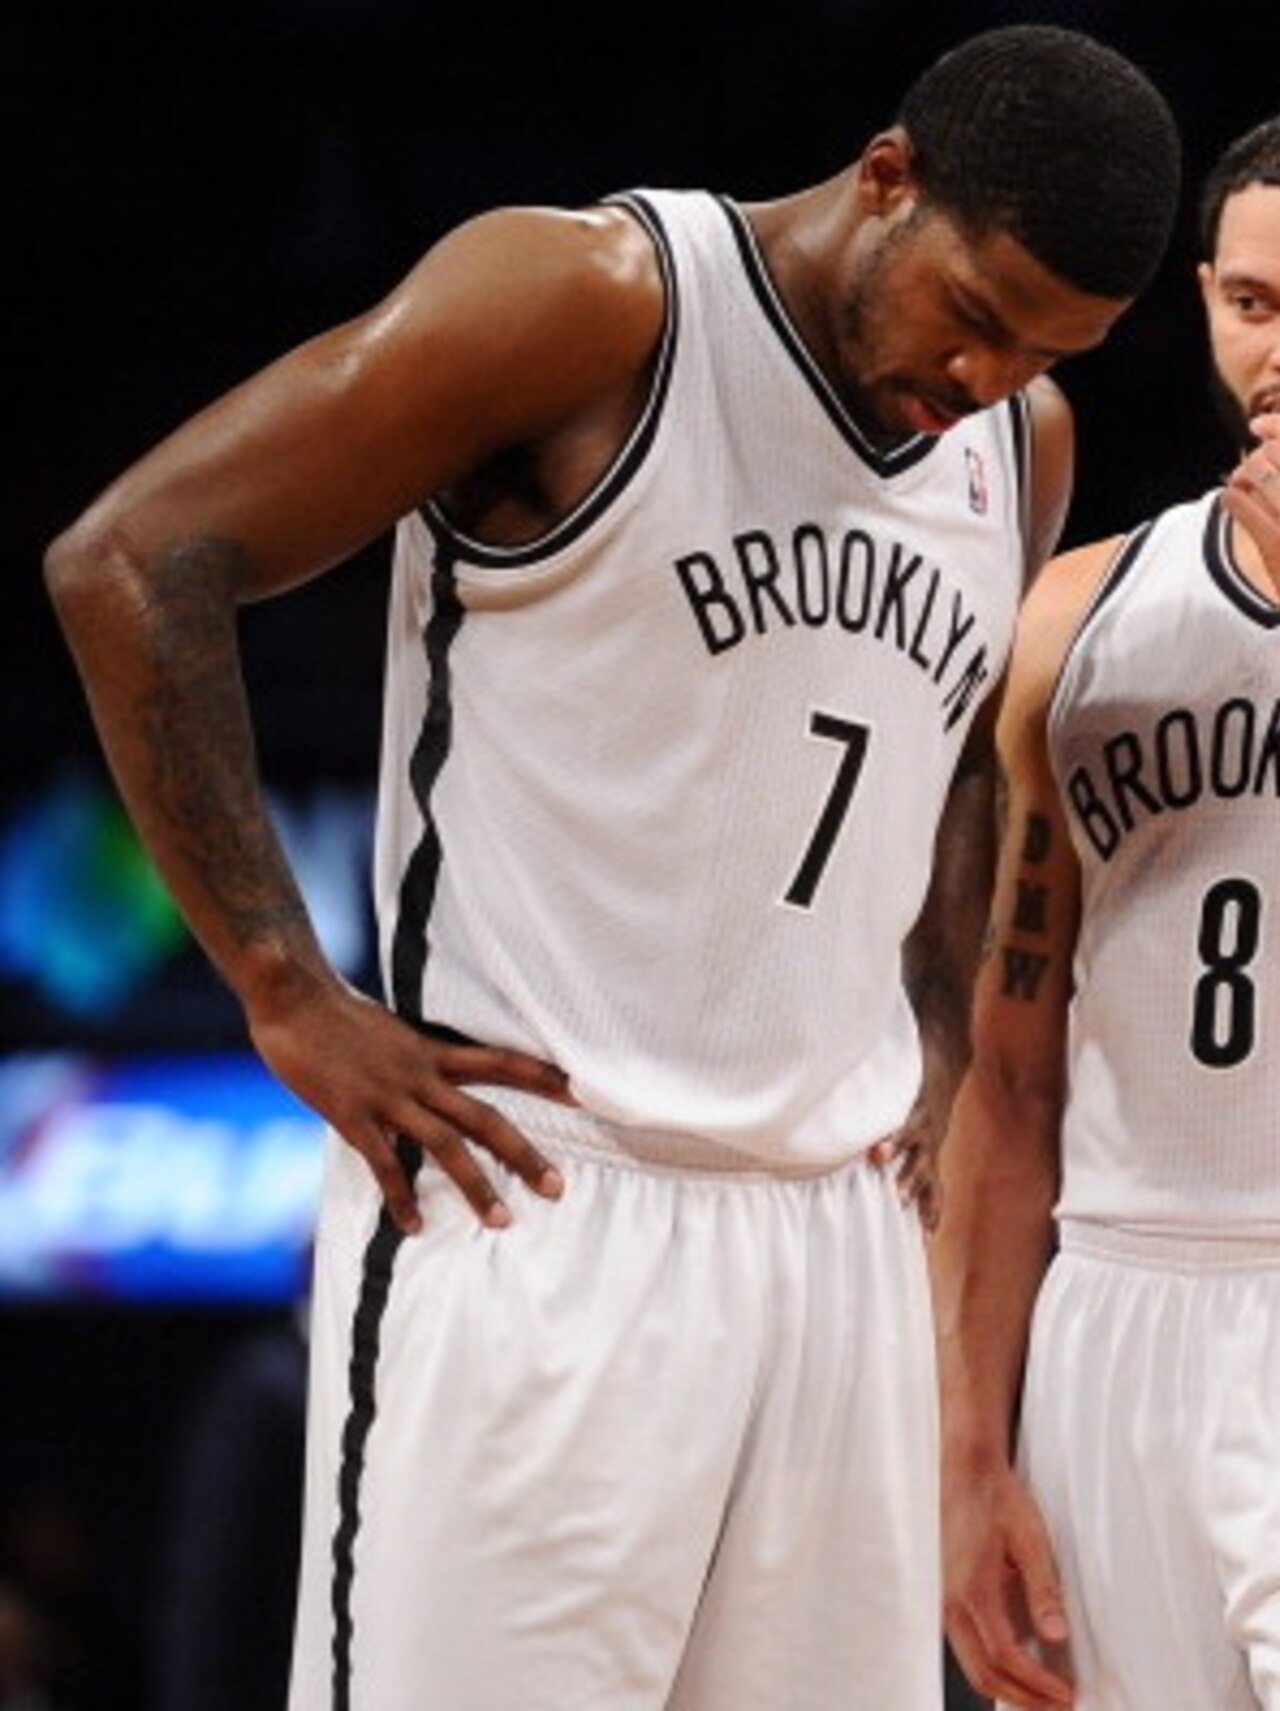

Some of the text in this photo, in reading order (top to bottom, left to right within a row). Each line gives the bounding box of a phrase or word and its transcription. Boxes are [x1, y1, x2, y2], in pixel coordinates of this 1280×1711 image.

[674, 523, 989, 734] BROOKLYN
[783, 711, 870, 909] 7
[1191, 877, 1260, 1068] 8
